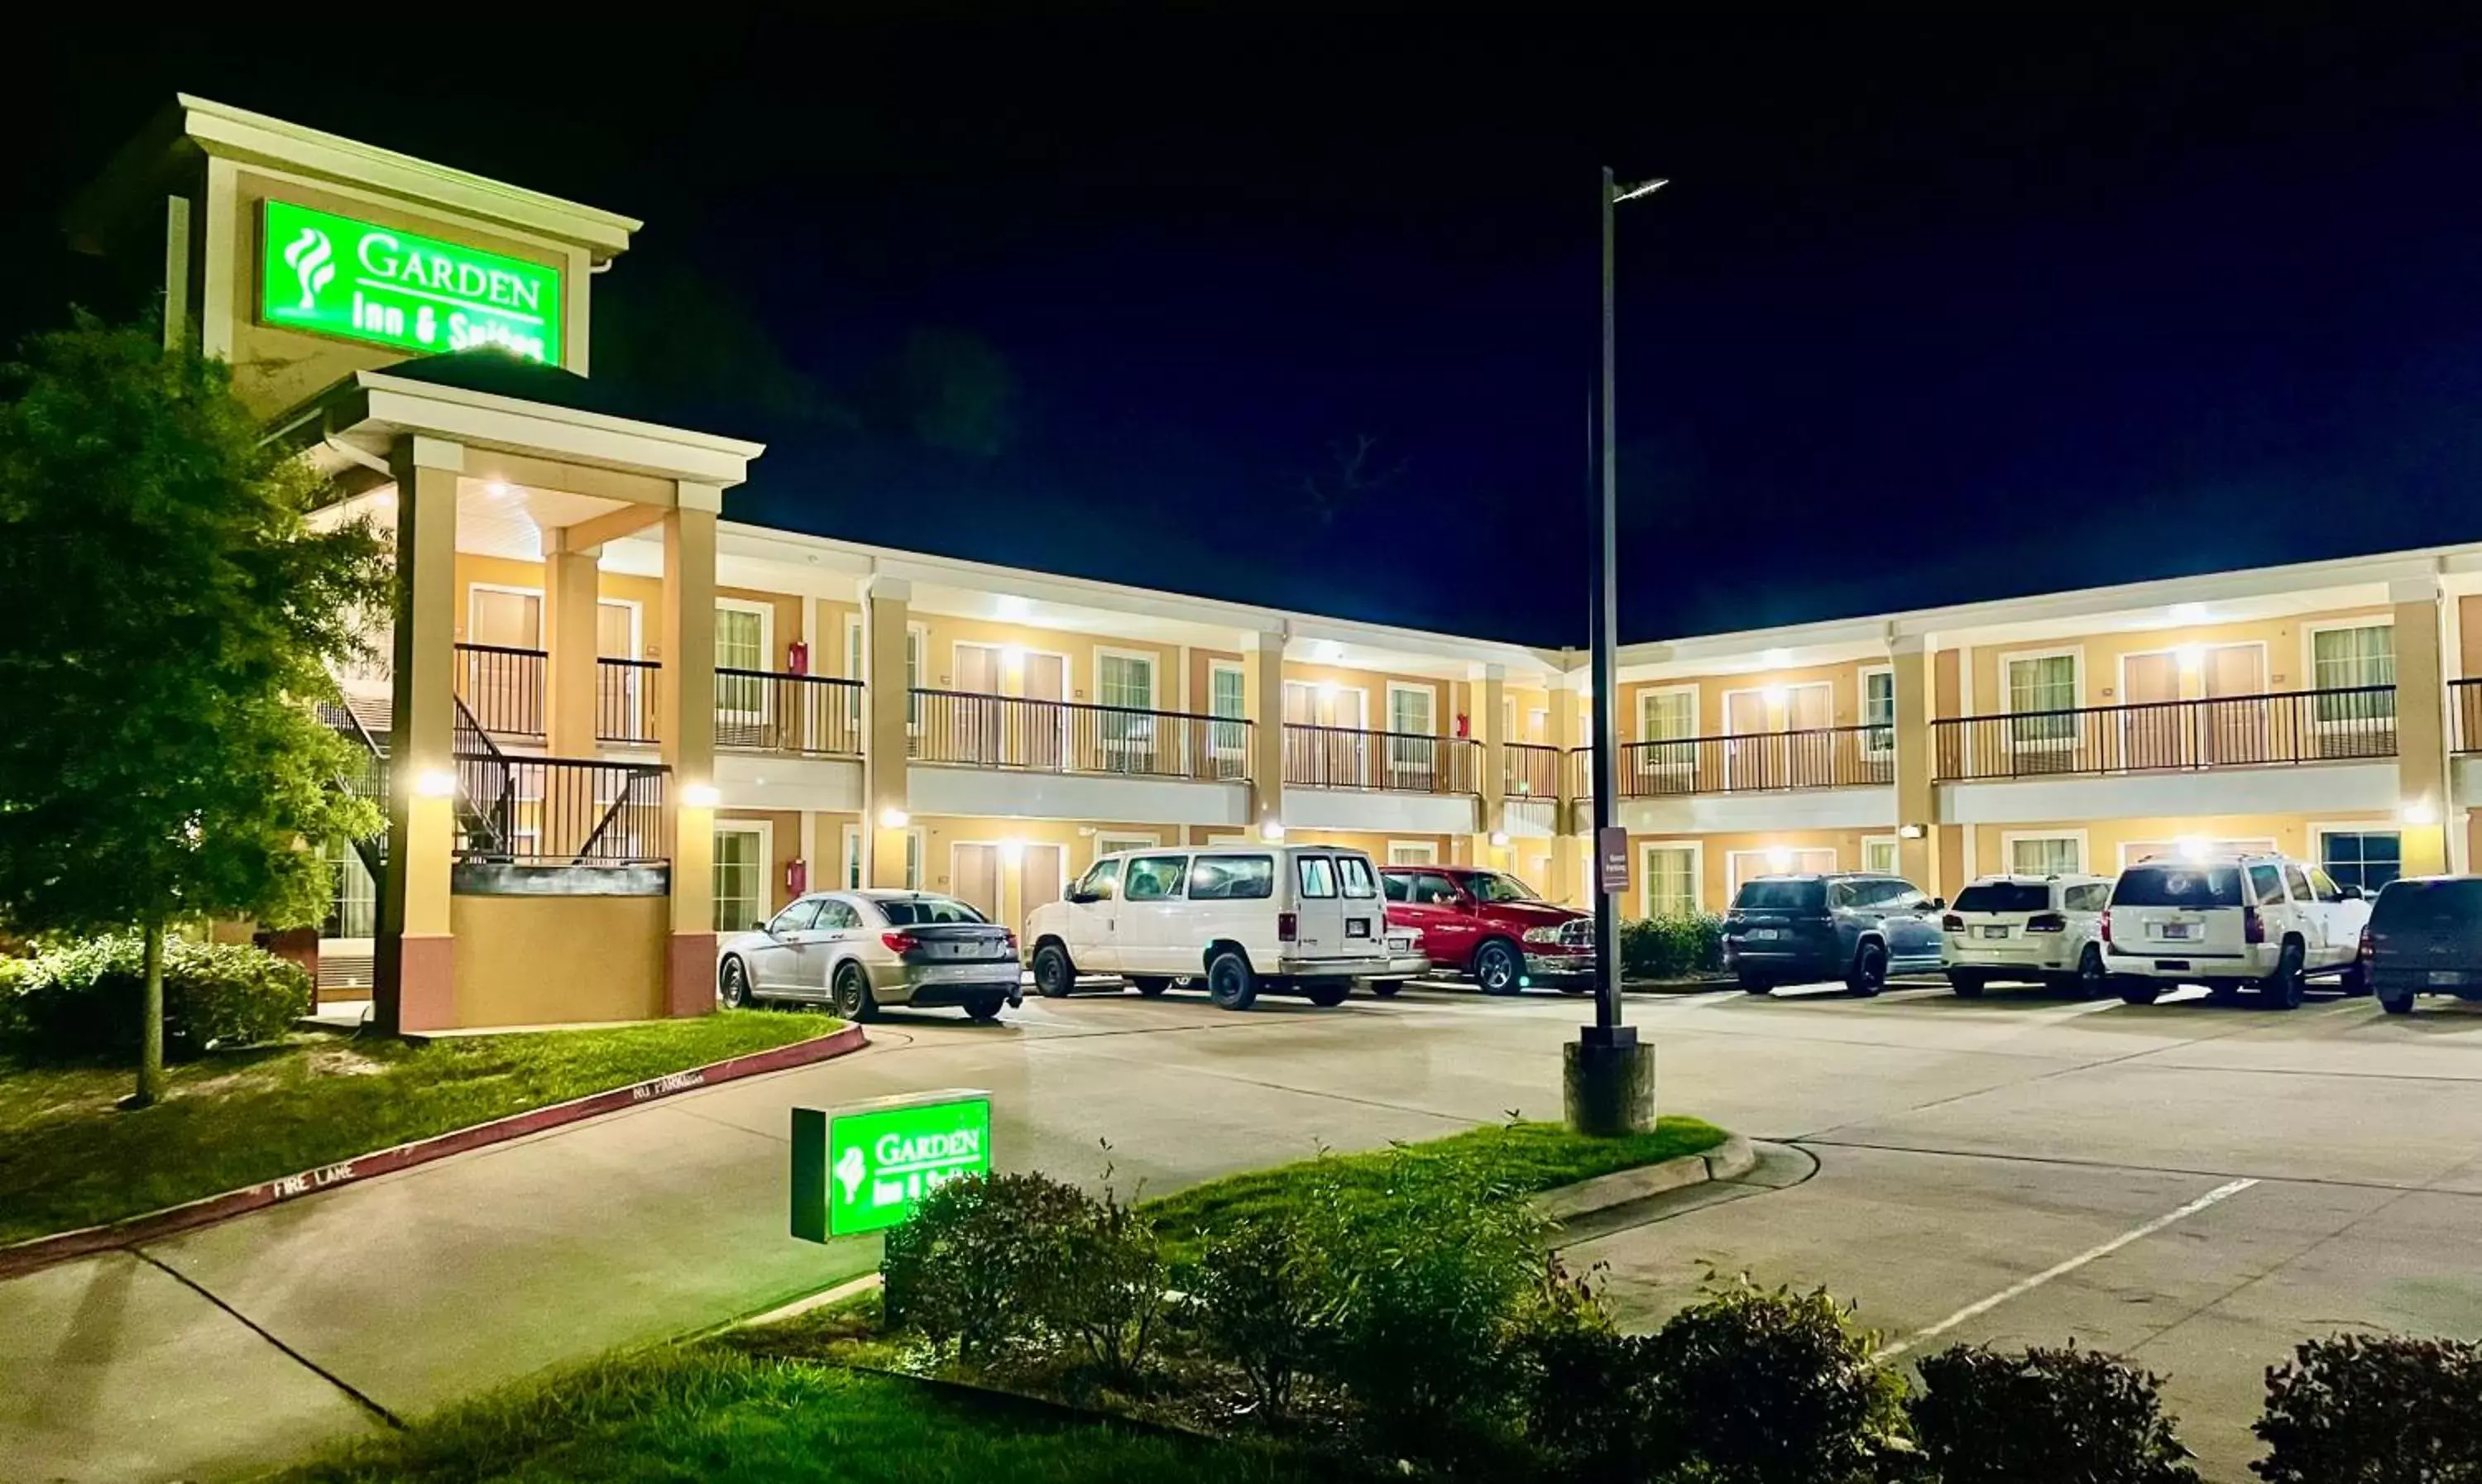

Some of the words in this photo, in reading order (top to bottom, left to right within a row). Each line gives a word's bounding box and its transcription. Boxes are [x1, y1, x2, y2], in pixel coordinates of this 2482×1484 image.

[357, 232, 540, 310] GARDEN
[352, 290, 404, 336] Inn
[416, 305, 436, 343] &
[875, 1127, 980, 1166] GARDEN
[273, 1173, 311, 1199] FIRE
[314, 1164, 355, 1185] LANE
